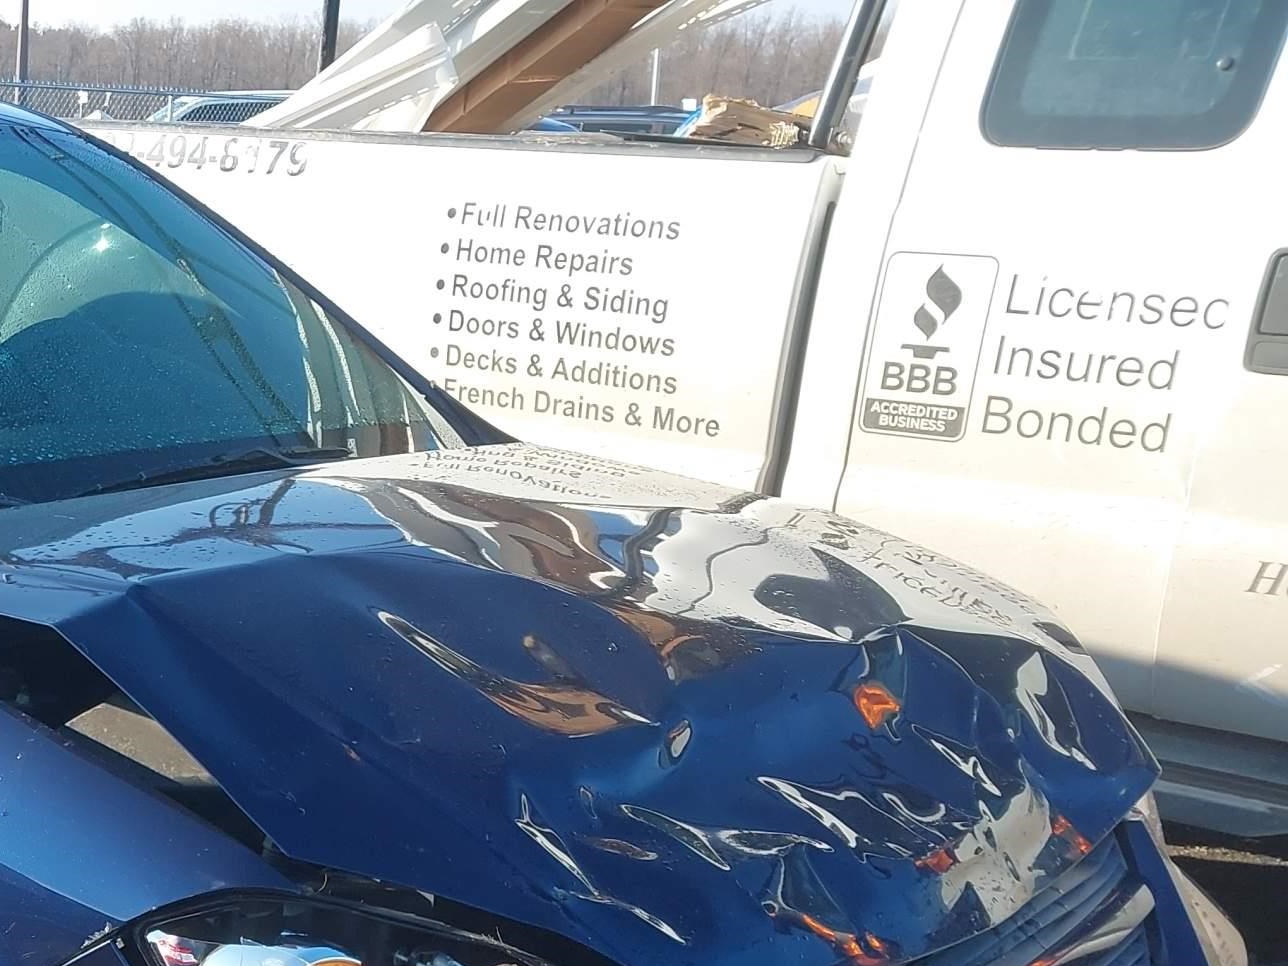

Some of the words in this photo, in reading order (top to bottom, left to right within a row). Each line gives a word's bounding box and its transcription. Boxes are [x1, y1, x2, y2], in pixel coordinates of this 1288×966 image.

[461, 202, 507, 229] Full
[515, 205, 681, 240] Renovations
[456, 238, 526, 266] Home
[536, 244, 634, 277] Repairs
[452, 274, 548, 311] Roofing
[557, 284, 574, 308] &
[584, 286, 669, 324] Siding
[448, 309, 519, 338] Doors
[528, 318, 545, 342] &
[556, 320, 676, 357] Windows
[445, 344, 517, 374] Decks
[526, 354, 543, 378] &
[551, 357, 678, 395] Additions
[880, 361, 958, 396] BBB
[994, 335, 1180, 390] Insured
[444, 378, 525, 411] French
[534, 390, 615, 423] Drains
[624, 402, 642, 427] &
[652, 406, 721, 437] More
[870, 401, 959, 421] ACCREDITED
[878, 413, 946, 432] BUSINESS
[982, 395, 1172, 453] Bonded
